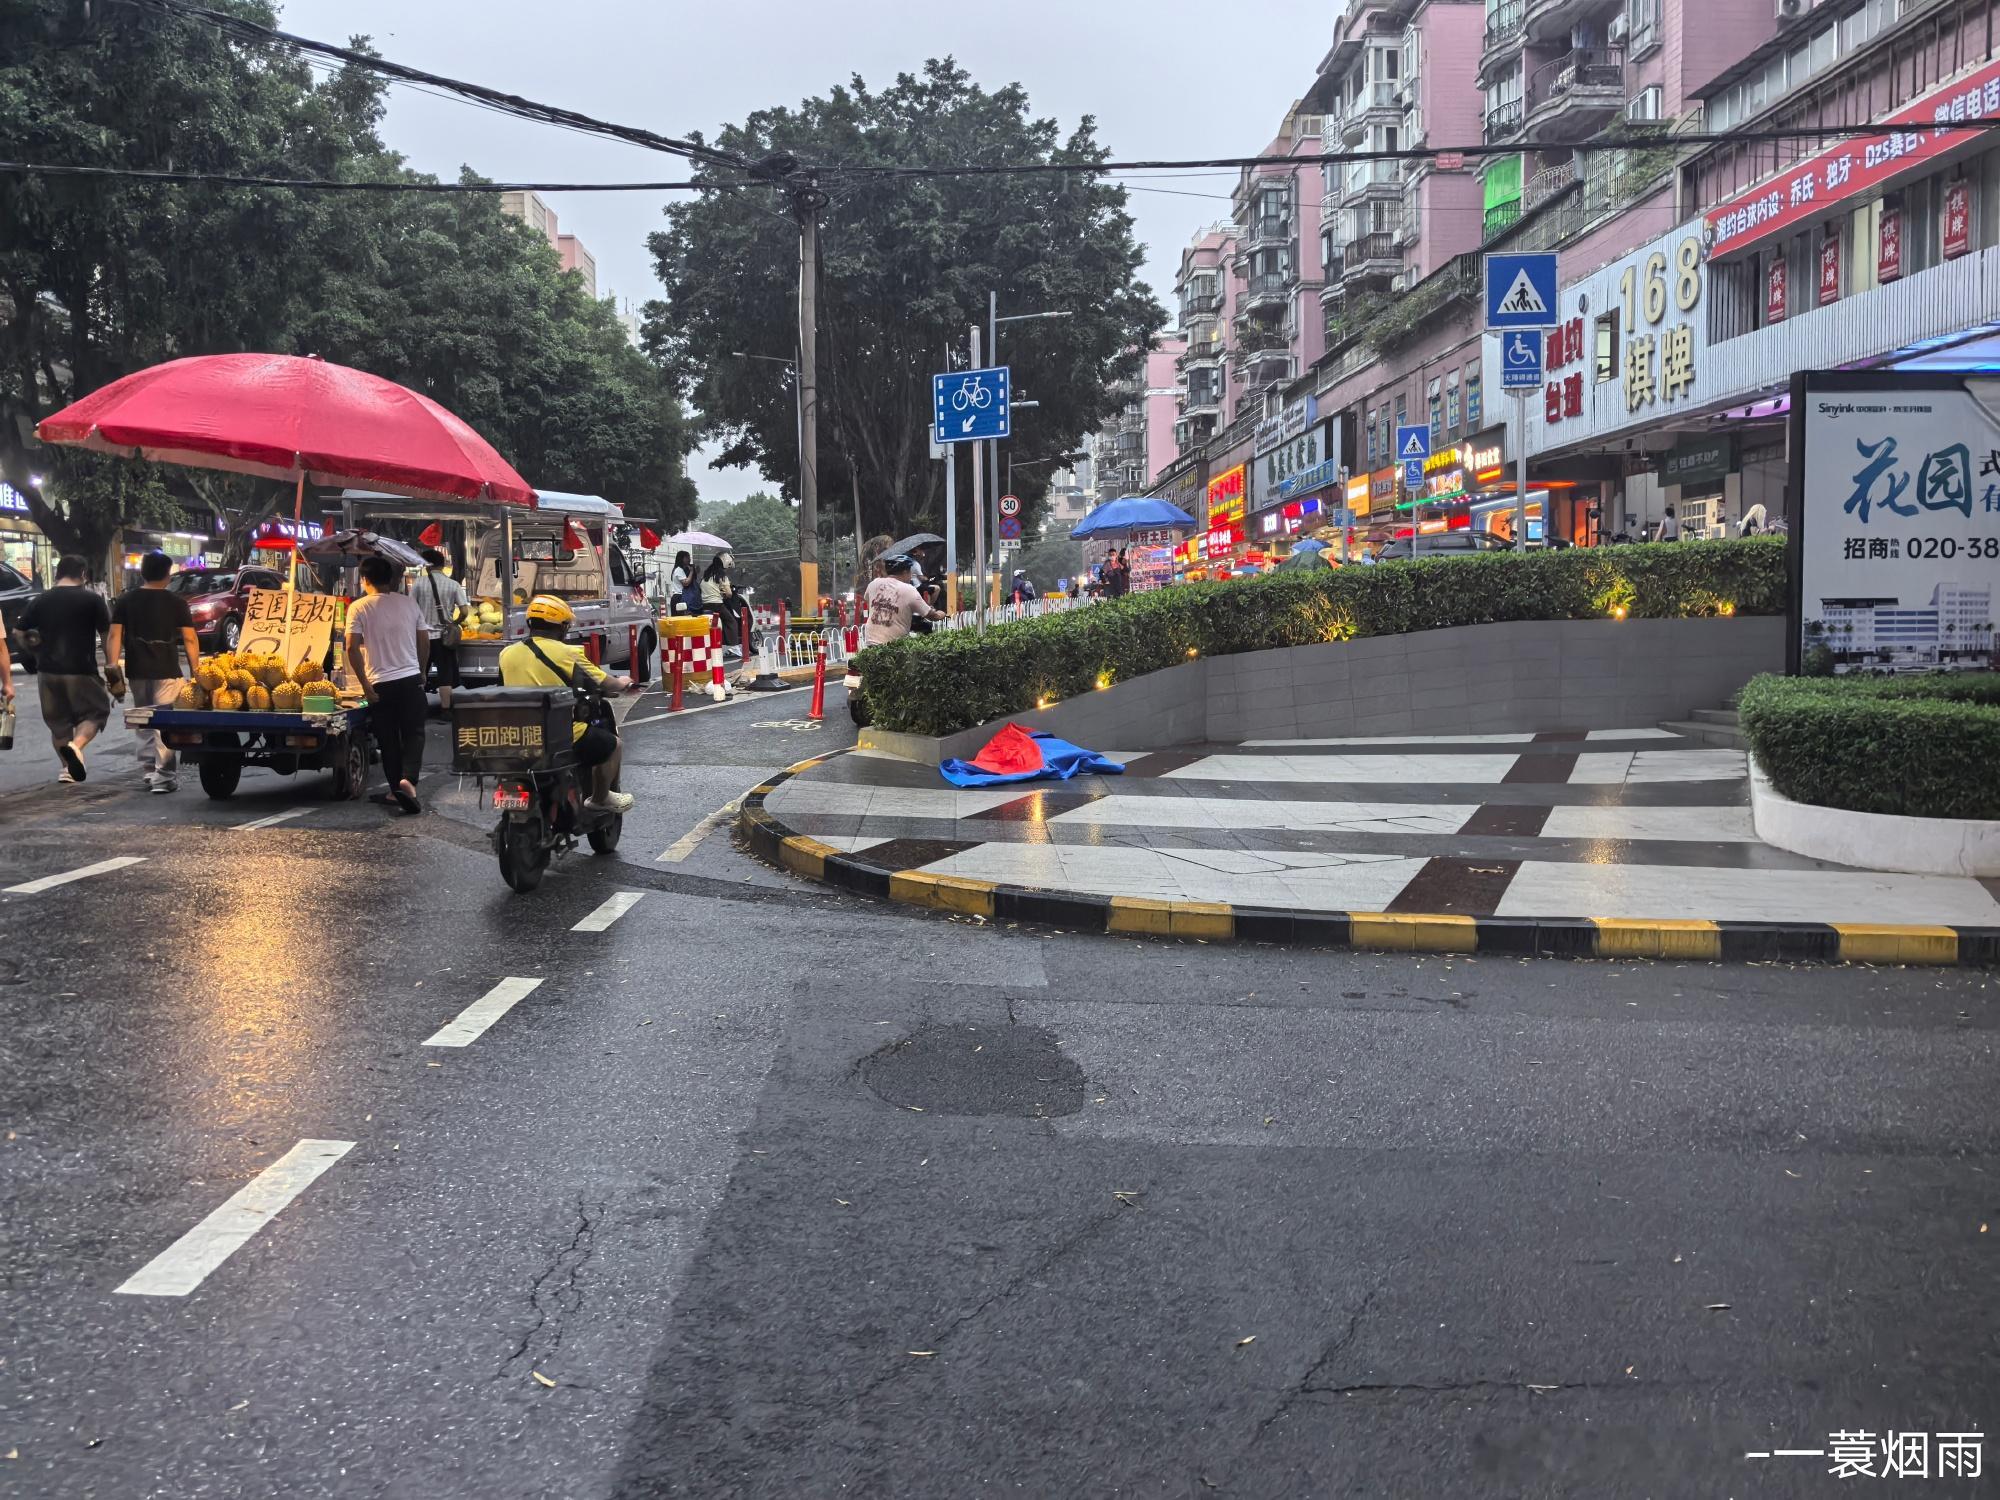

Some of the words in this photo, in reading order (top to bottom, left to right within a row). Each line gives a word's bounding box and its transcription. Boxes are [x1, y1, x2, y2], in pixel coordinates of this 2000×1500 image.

[1950, 193, 1965, 236] 棋牌
[1883, 219, 1897, 263] 棋牌
[1620, 236, 1701, 333] 168
[1623, 323, 1695, 412] 棋牌
[1546, 371, 1584, 424] 台球
[1818, 402, 1854, 416] Sinyink
[1844, 436, 1972, 523] 花园
[1003, 500, 1016, 511] 30
[1907, 536, 2000, 560] 020-38
[458, 725, 543, 749] 美团跑腿
